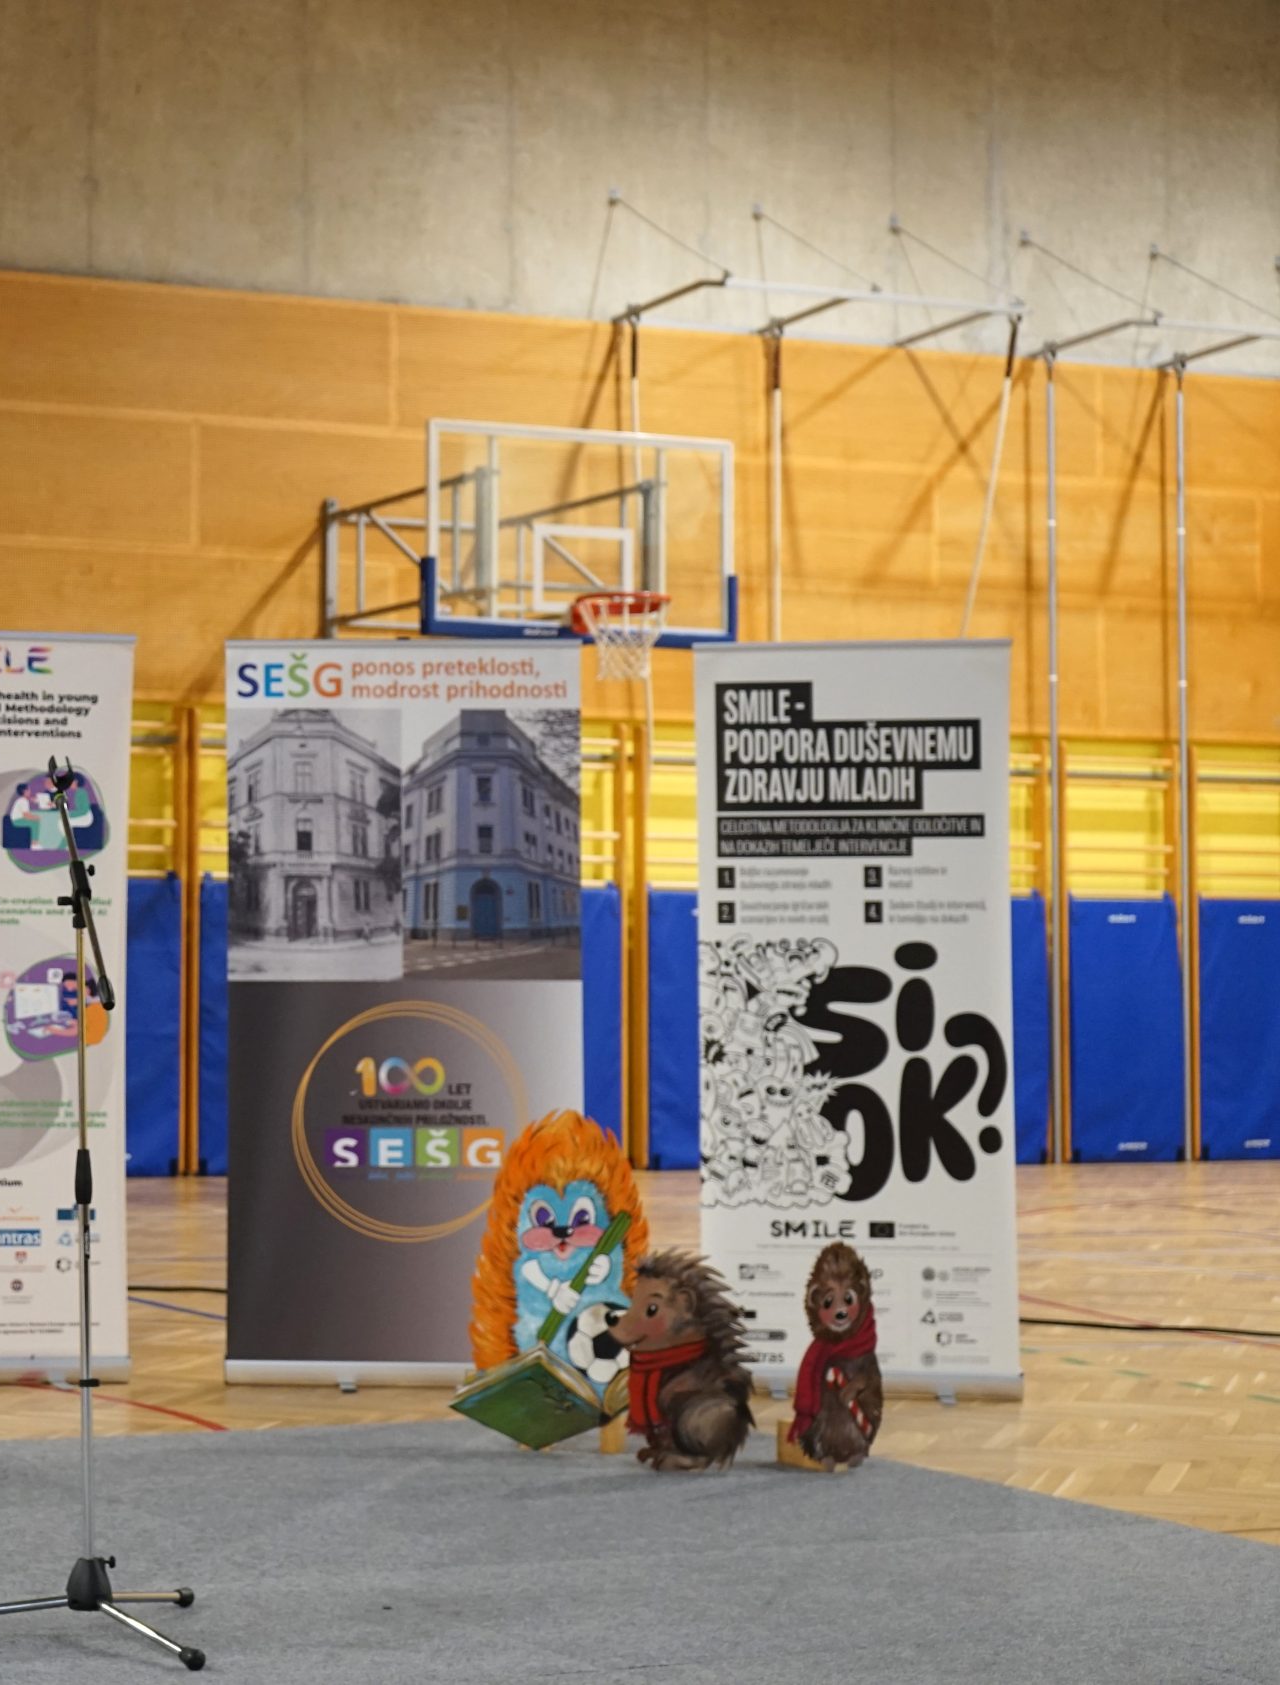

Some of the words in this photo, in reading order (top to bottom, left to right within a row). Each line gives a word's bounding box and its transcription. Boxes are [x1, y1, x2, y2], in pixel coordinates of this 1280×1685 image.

[236, 652, 344, 699] SEŠG
[351, 659, 415, 679] ponos
[421, 657, 541, 680] preteklosti,
[351, 680, 439, 699] modrost
[446, 680, 568, 702] prihodnosti
[5, 704, 91, 716] Methodology
[42, 691, 55, 701] in
[58, 693, 98, 704] young
[723, 689, 792, 725] SMILE
[43, 716, 68, 726] and
[723, 727, 830, 764] PODPORA
[833, 721, 974, 763] DUŠEVNEMU
[724, 767, 825, 804] ZDRAVJU
[829, 766, 916, 803] MLADIH
[792, 940, 938, 1079] Si
[355, 1056, 446, 1098] 100
[448, 1083, 472, 1096] LET
[433, 1099, 473, 1111] OKOLJE
[821, 1012, 1008, 1202] OK?
[331, 1128, 503, 1169] SEŠG
[770, 1219, 856, 1239] SMILE
